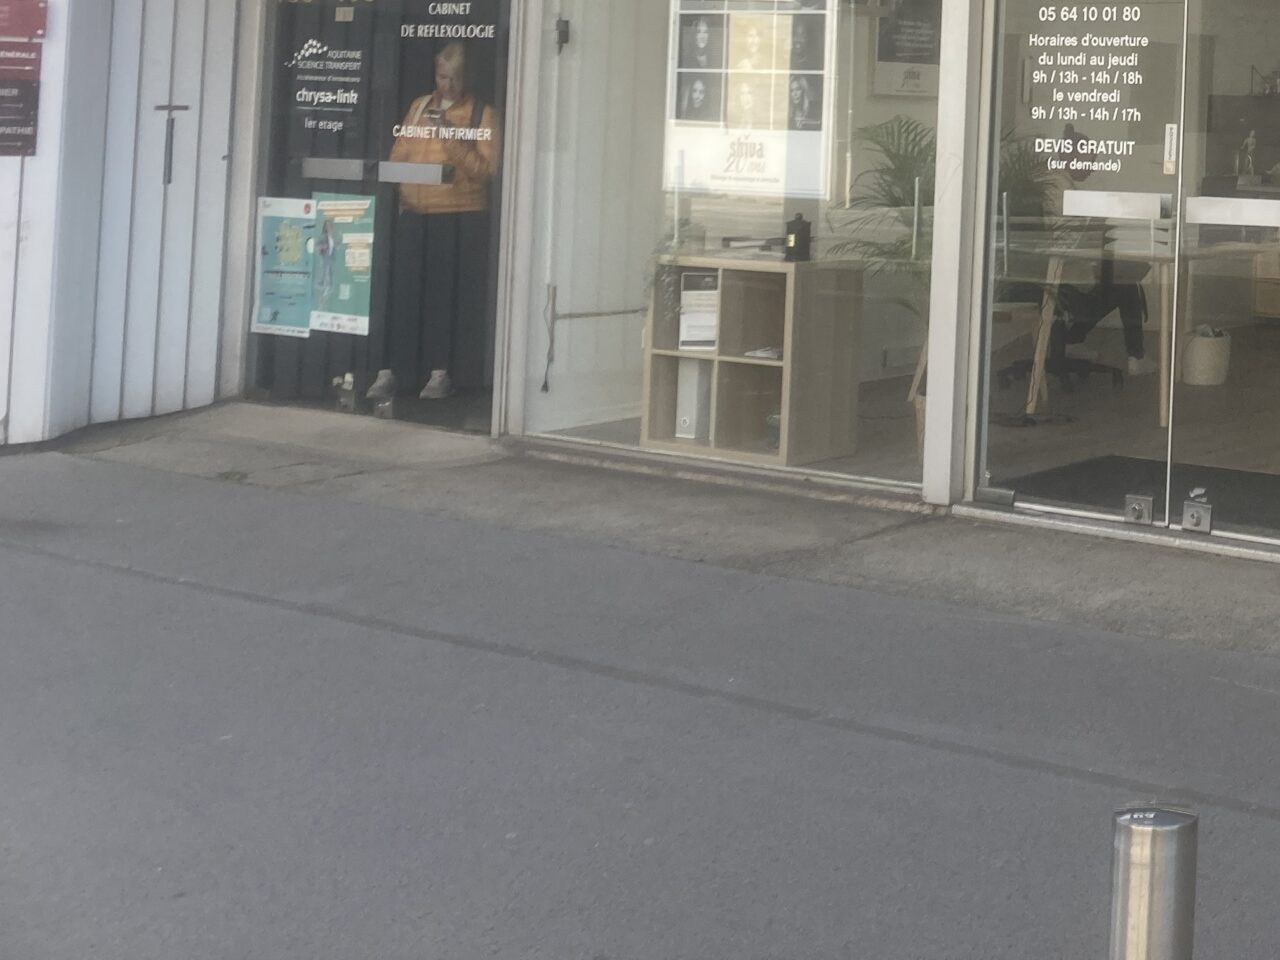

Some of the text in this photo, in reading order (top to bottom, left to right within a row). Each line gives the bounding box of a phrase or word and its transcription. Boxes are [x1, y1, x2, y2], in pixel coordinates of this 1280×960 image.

[428, 2, 472, 16] CABINET
[1038, 6, 1141, 22] 05 64 10 01 80
[401, 24, 414, 38] DE
[1028, 33, 1149, 48] Horaires d'ouverture
[1038, 53, 1138, 70] du lundi au jeudi
[1032, 71, 1047, 84] 9h
[1058, 71, 1078, 84] 13h
[1090, 71, 1110, 85] 14h
[1122, 71, 1143, 85] 18h
[296, 87, 359, 106] chrysa-link
[1052, 89, 1121, 103] le vendredi
[1031, 106, 1046, 120] 9h
[1057, 107, 1077, 120] 13h
[1089, 107, 1110, 121] 14h
[1121, 108, 1141, 122] 17h
[392, 125, 492, 141] CABINET INFIRMIER
[1034, 138, 1136, 156] DEVIS GRATUIT
[1047, 157, 1122, 173] (sur demande)
